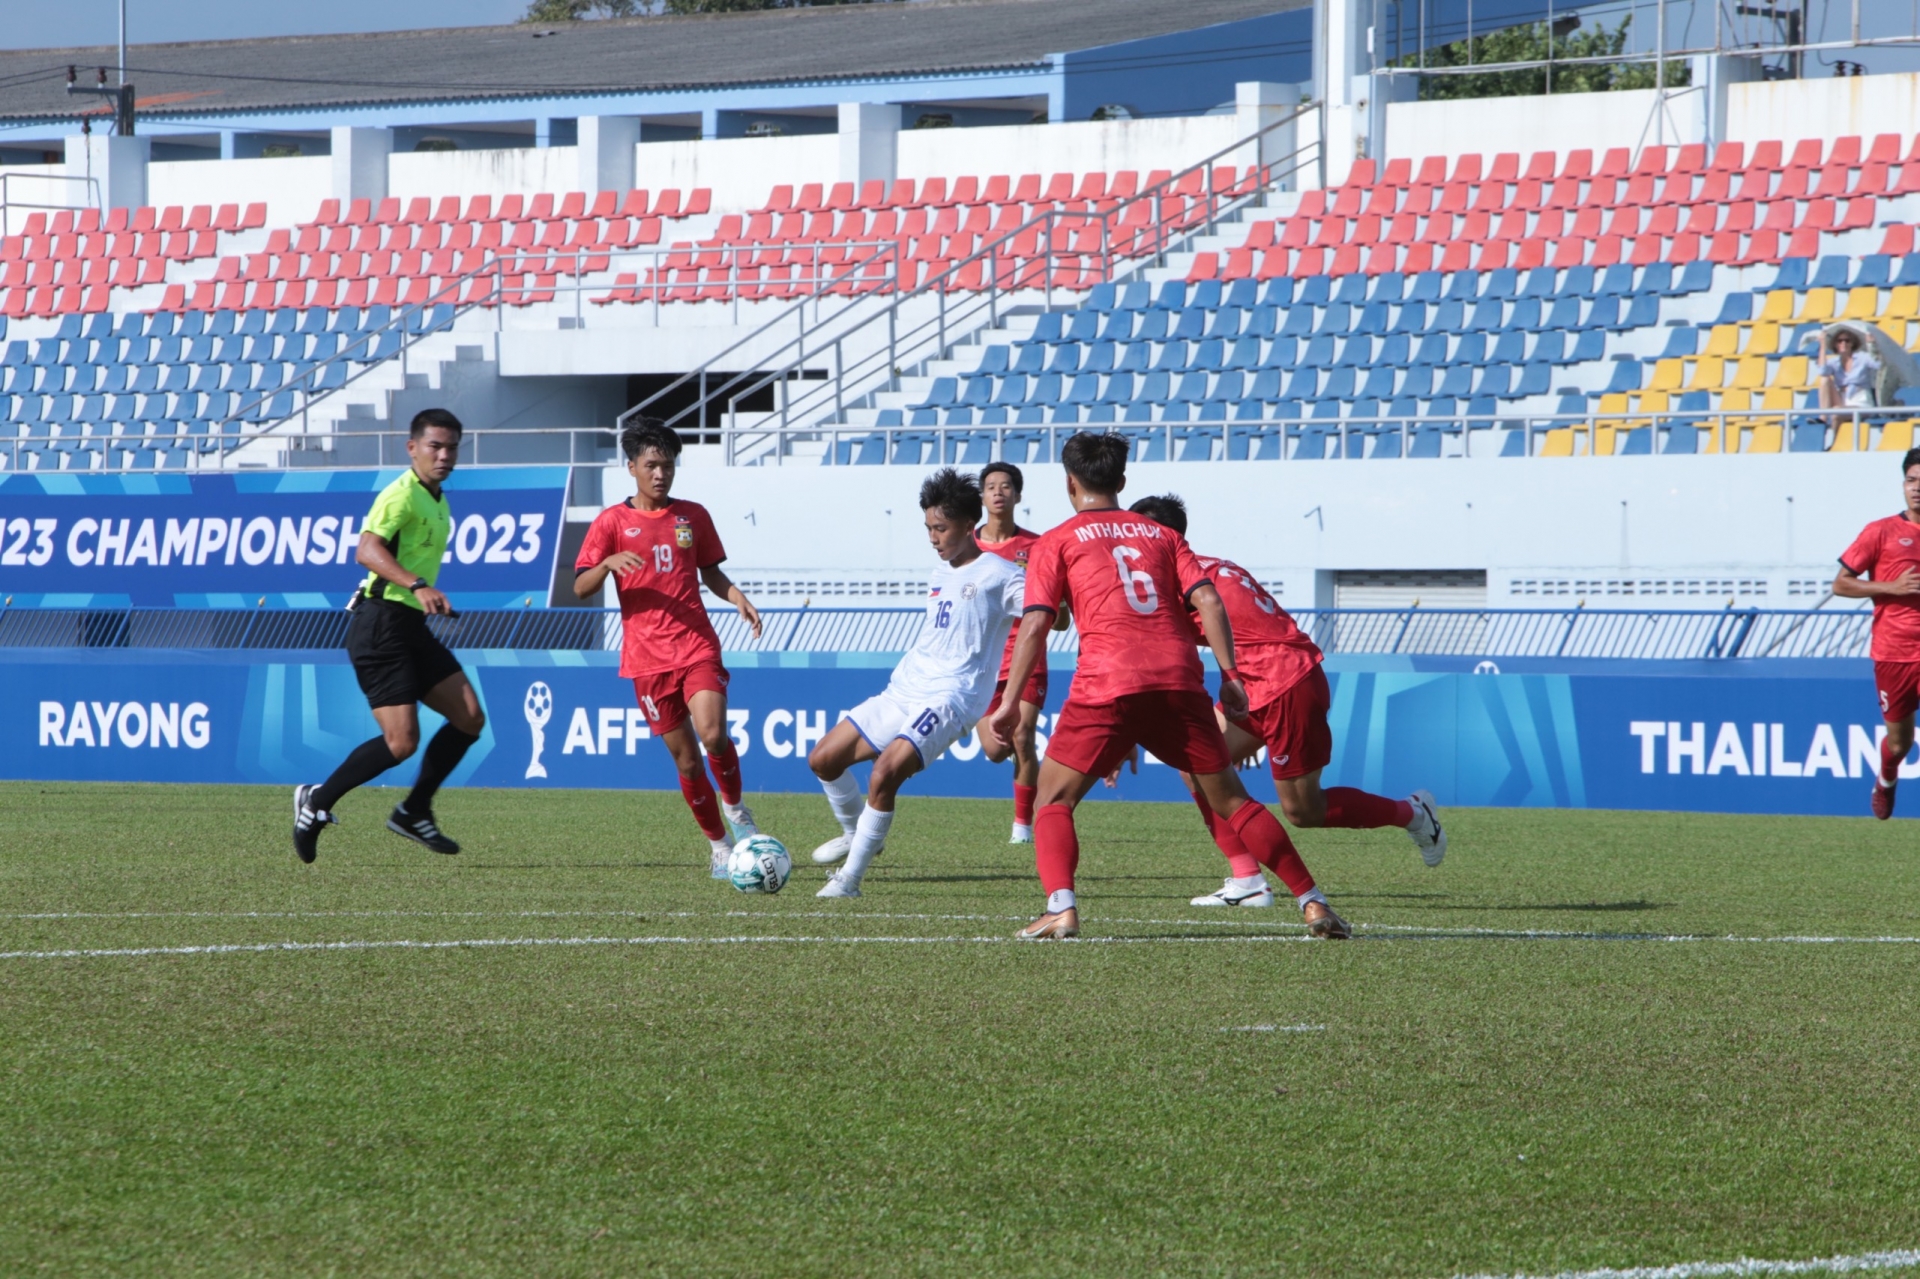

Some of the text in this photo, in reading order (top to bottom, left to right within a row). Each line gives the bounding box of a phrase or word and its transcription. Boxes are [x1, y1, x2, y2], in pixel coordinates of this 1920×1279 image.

[66, 515, 368, 567] CHAMPIONSH
[652, 544, 674, 573] 19
[1112, 544, 1159, 615] 6
[934, 600, 953, 629] 16
[39, 701, 210, 749] RAYONG
[562, 707, 651, 755] AFF
[911, 707, 940, 737] 16
[761, 857, 779, 890] SELECT
